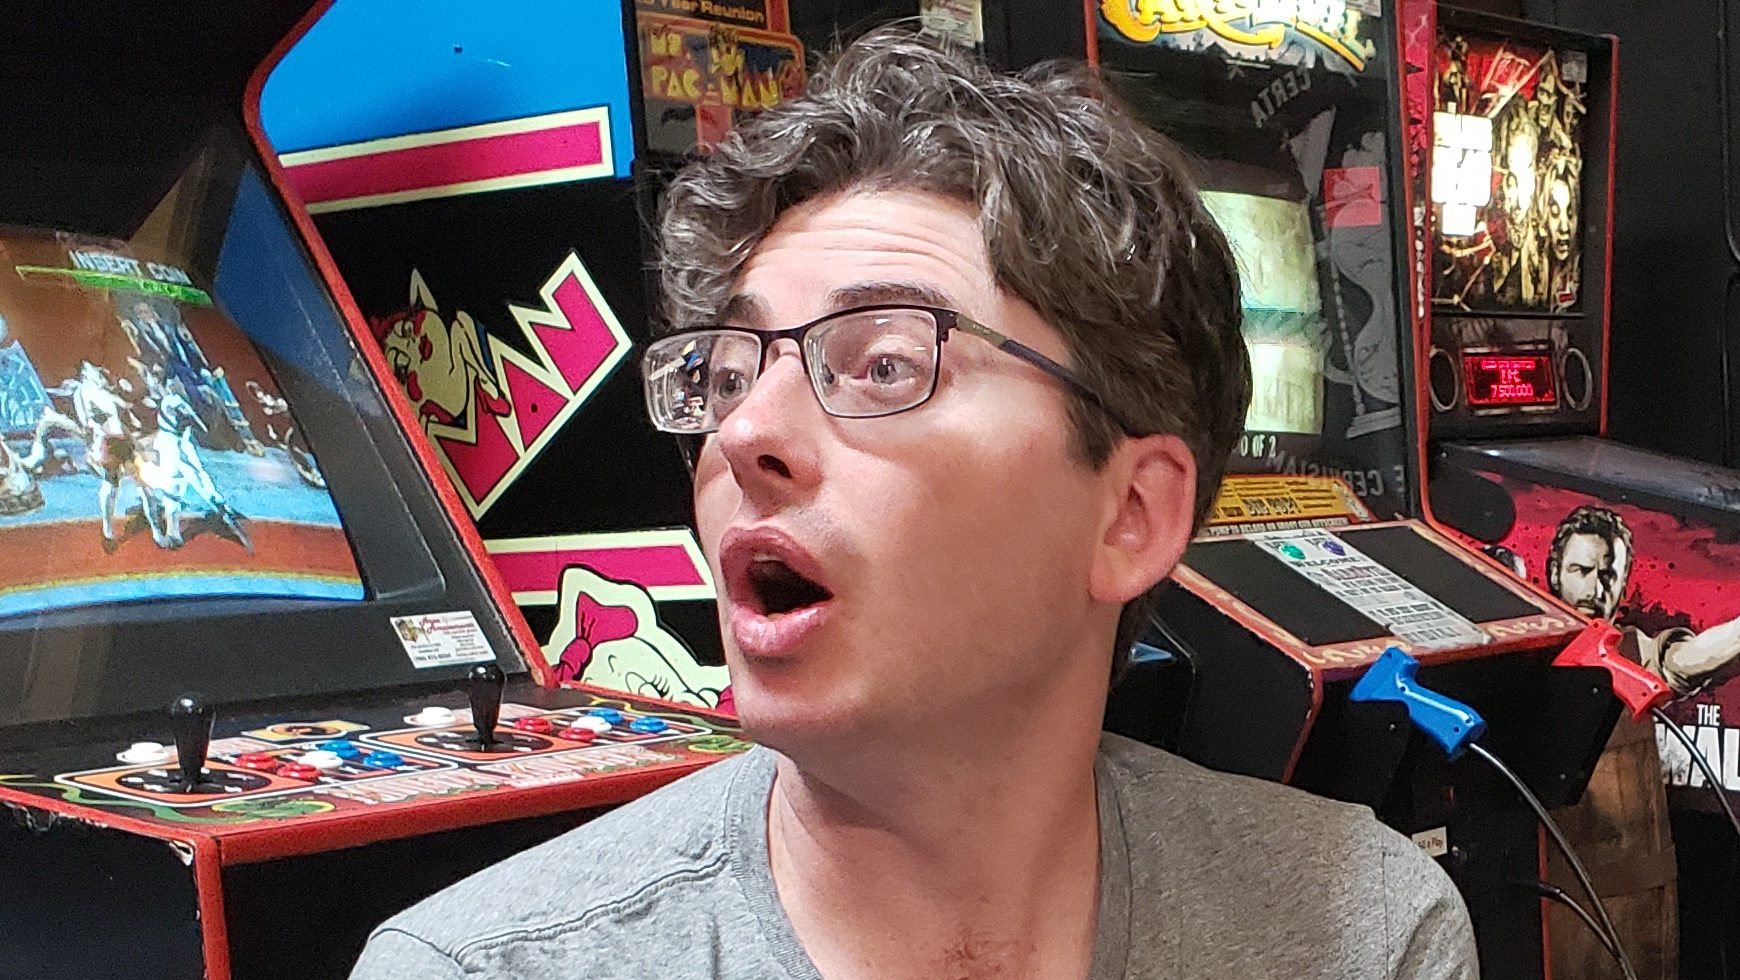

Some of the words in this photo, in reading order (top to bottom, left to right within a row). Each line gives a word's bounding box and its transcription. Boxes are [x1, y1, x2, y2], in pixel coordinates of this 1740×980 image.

[701, 1, 764, 23] Reunion
[68, 250, 144, 278] INSERT
[1252, 434, 1266, 458] OF
[1269, 434, 1277, 458] 2
[1696, 703, 1721, 727] THE
